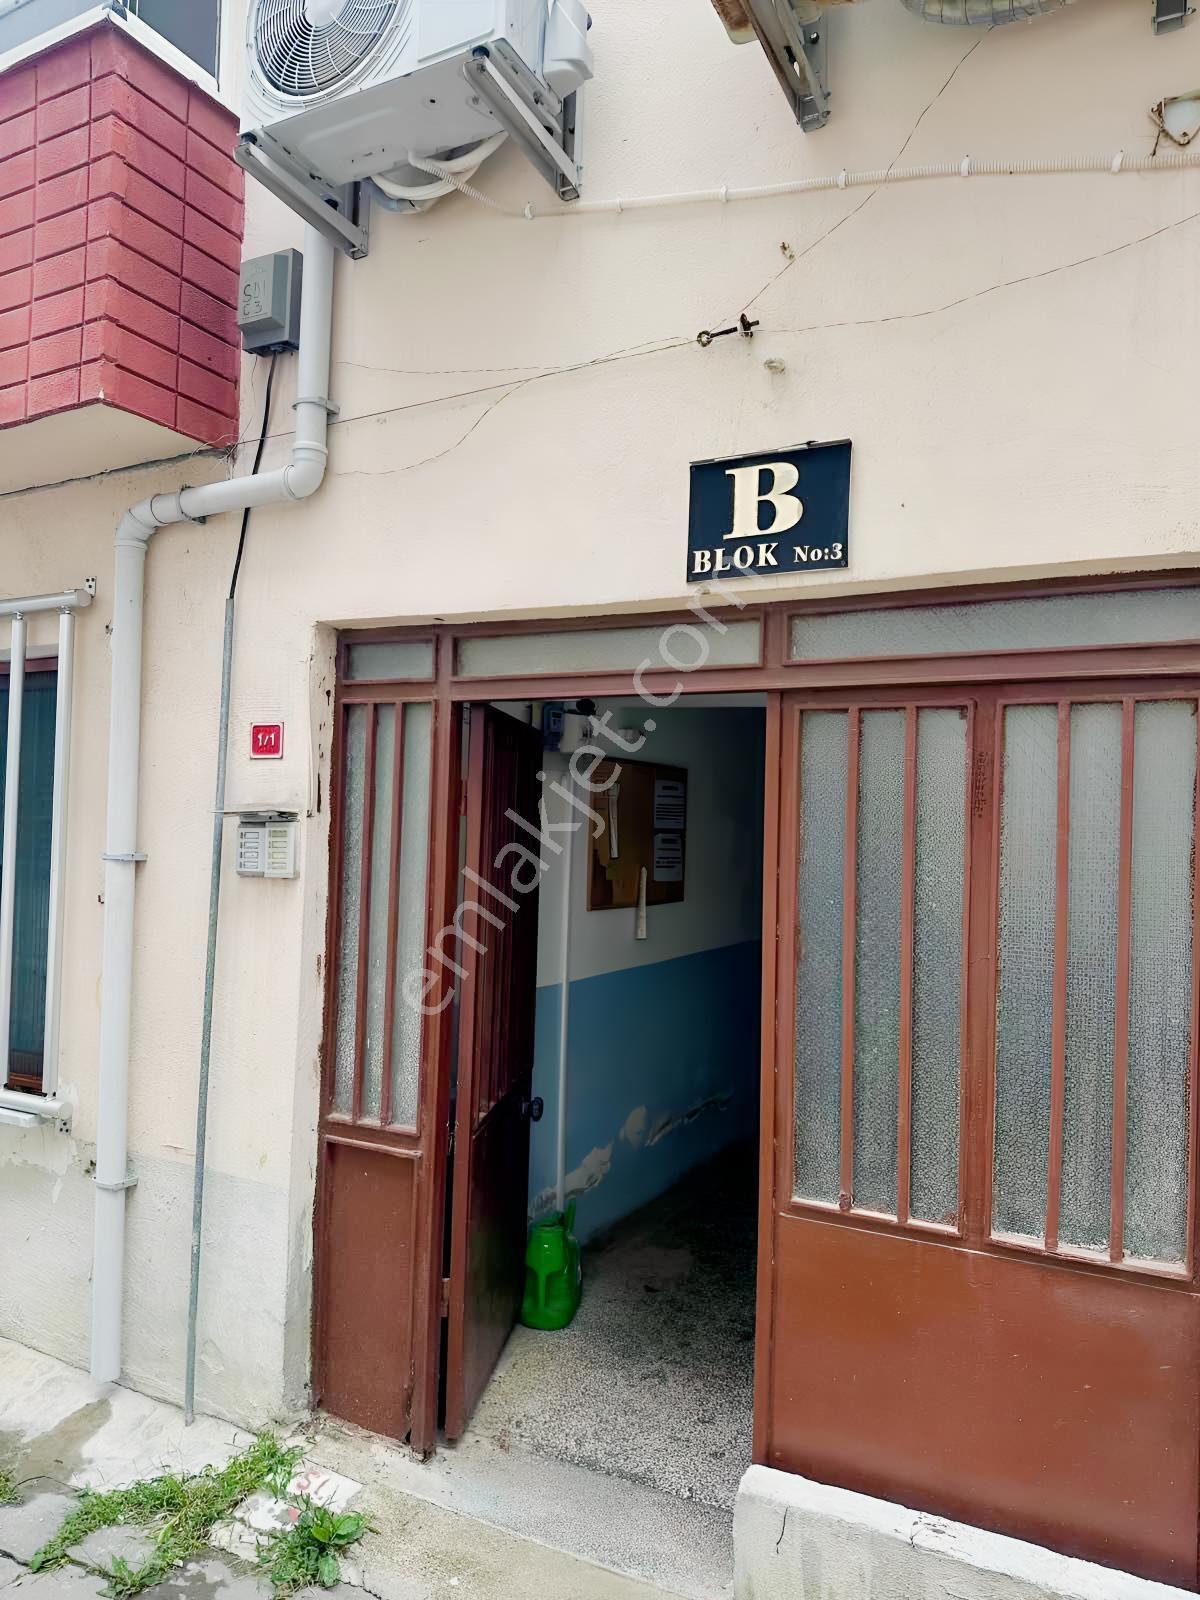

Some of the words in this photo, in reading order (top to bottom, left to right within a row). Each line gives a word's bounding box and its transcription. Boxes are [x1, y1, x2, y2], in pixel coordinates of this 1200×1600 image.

[723, 462, 803, 539] B
[692, 543, 778, 573] BLOK
[793, 543, 842, 563] No:3
[257, 732, 275, 747] 1/1
